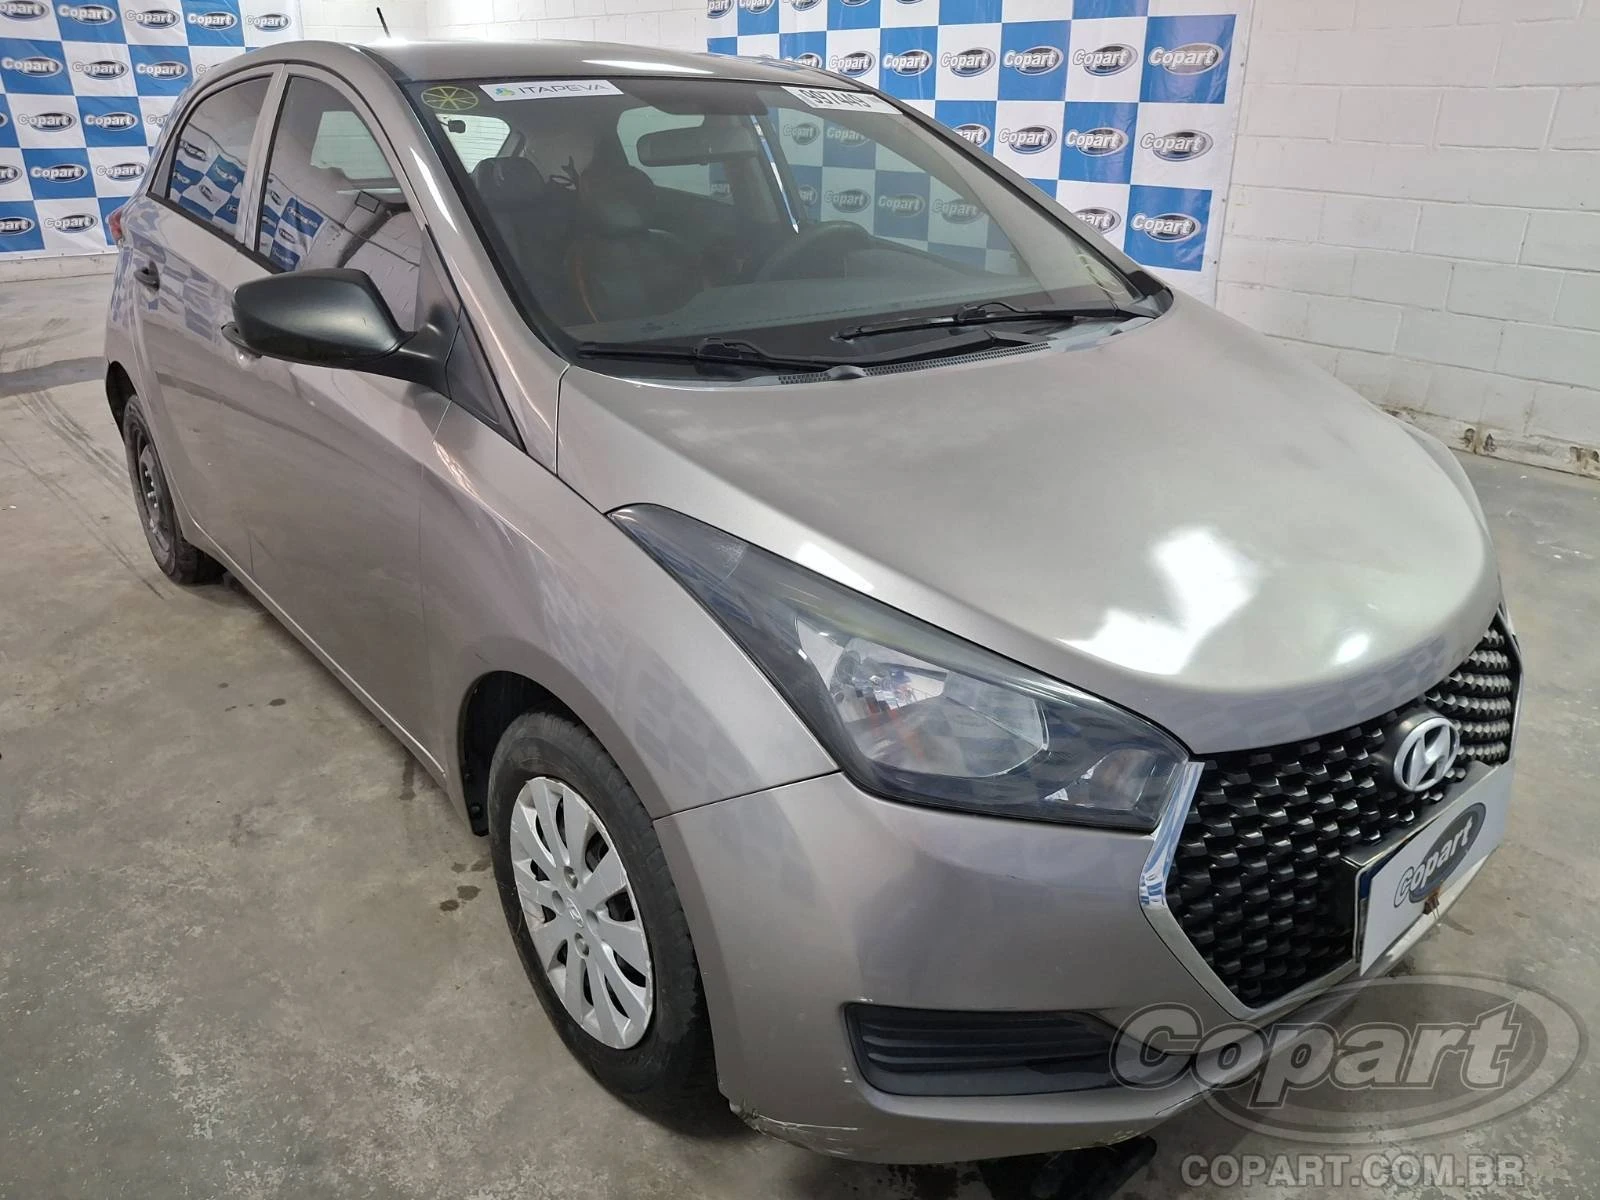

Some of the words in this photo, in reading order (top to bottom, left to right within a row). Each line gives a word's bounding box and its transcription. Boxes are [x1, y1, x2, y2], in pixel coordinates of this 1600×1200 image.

[59, 5, 110, 20] Copart
[126, 9, 173, 24] Copart
[187, 13, 232, 27] Copart
[246, 15, 286, 27] Copart
[829, 55, 869, 71] Copart
[883, 53, 926, 72] Copart
[941, 52, 988, 71] Copart
[1003, 49, 1055, 69] Copart
[1073, 48, 1127, 67] Copart
[1149, 46, 1215, 67] Copart
[2, 57, 56, 76] Copart
[73, 62, 121, 75] Copart
[136, 63, 182, 75] Copart
[518, 84, 610, 95] ITAPEVA
[19, 114, 69, 128] Copart
[84, 114, 133, 128] Copart
[783, 123, 814, 138] Copart
[999, 128, 1049, 145] Copart
[1065, 129, 1119, 149] Copart
[1140, 133, 1202, 153] Copart
[30, 166, 80, 179] Copart
[96, 165, 141, 178] Copart
[824, 190, 864, 206] Copart
[879, 195, 920, 212] Copart
[931, 199, 977, 215] Copart
[44, 217, 91, 231] Copart
[1131, 213, 1196, 236] Copart
[1394, 816, 1473, 908] Copart
